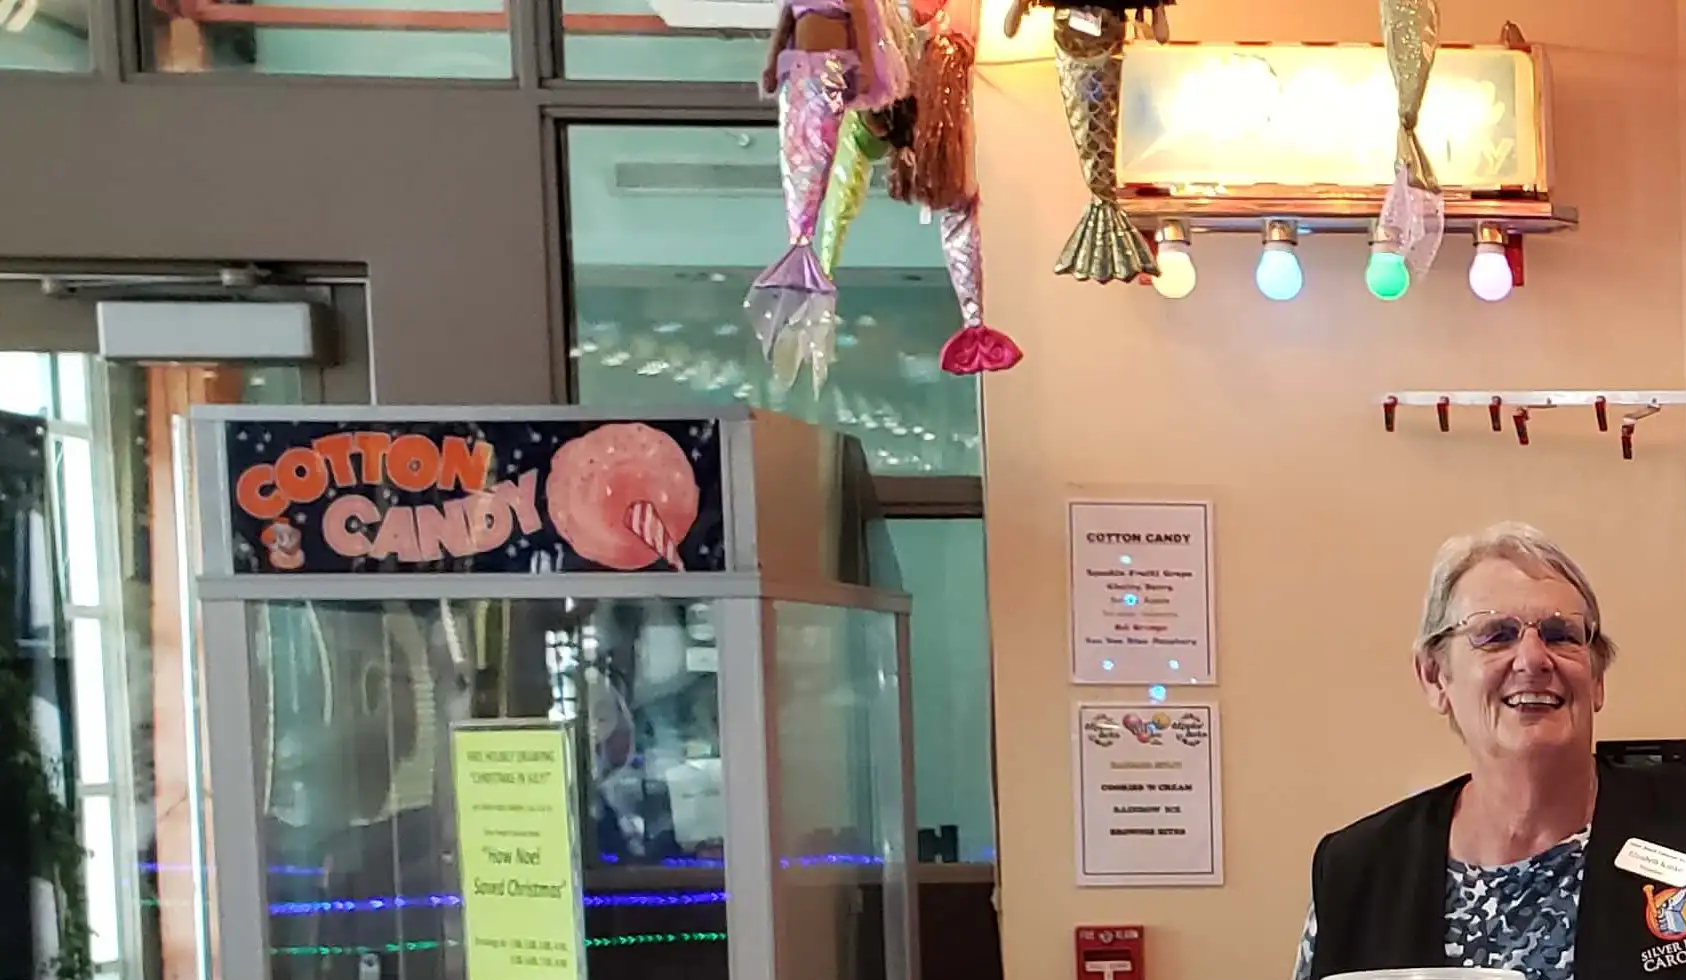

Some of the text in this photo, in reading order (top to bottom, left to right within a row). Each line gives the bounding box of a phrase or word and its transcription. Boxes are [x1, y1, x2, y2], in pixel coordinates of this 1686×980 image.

[235, 430, 495, 520] COTTON
[322, 468, 544, 562] CANDY
[1086, 532, 1192, 544] COTTON CANDY
[1641, 940, 1682, 963] SILVER
